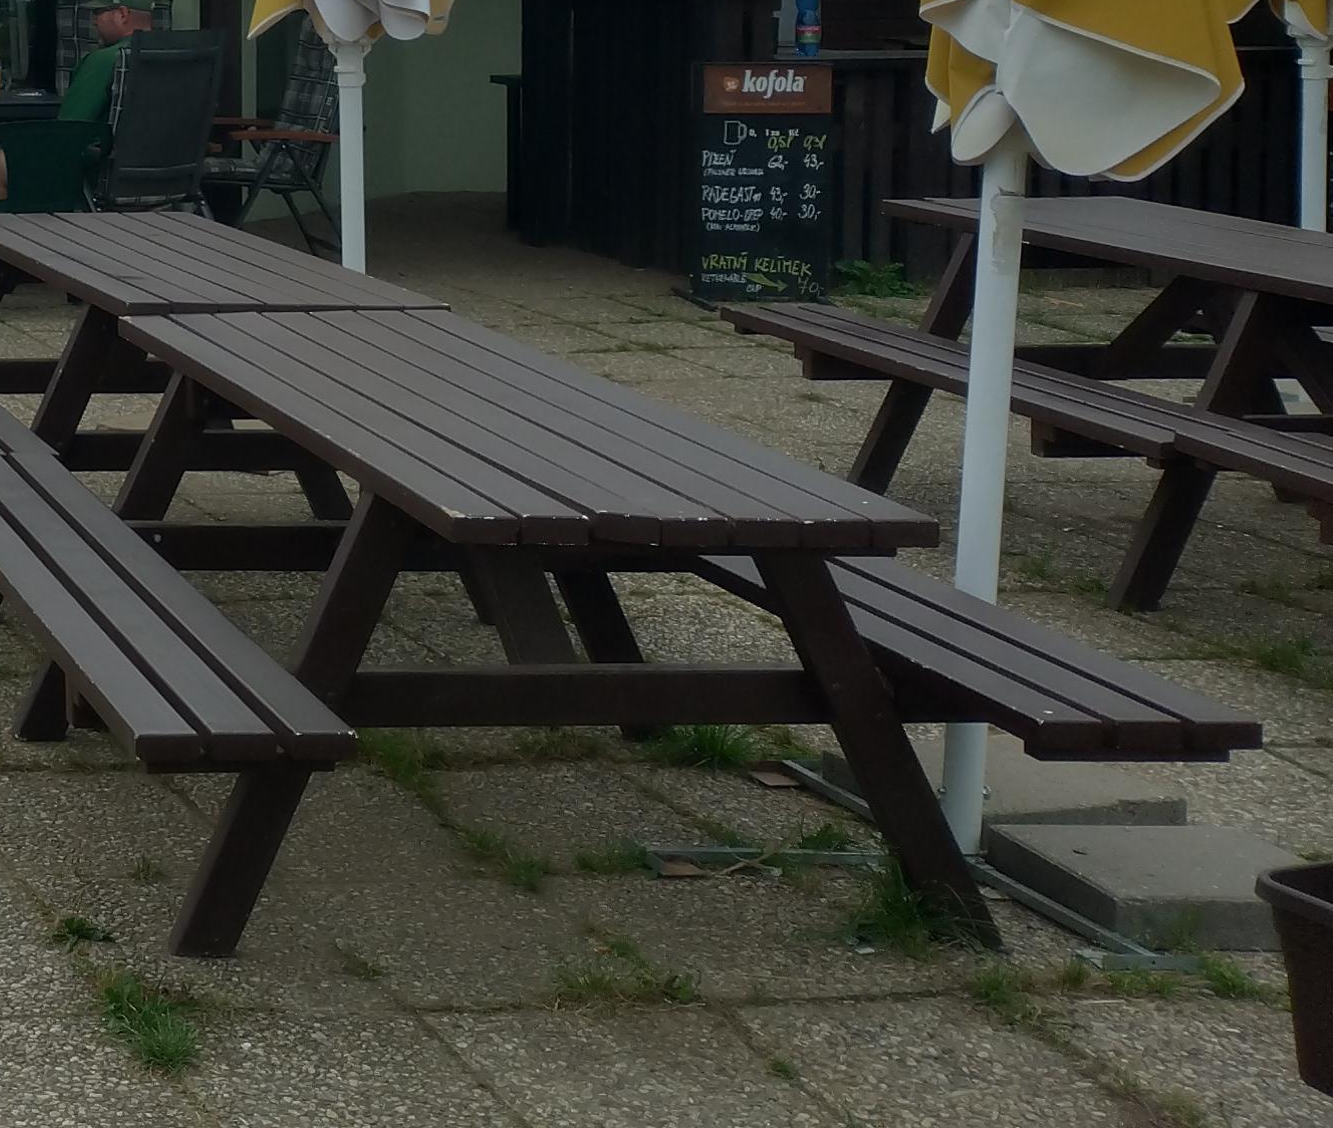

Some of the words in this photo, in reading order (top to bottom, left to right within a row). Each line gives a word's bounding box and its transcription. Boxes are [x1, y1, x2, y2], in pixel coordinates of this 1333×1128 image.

[741, 69, 806, 99] kofola
[701, 251, 749, 271] VRATNÝ
[754, 256, 813, 276] KELÍMEK
